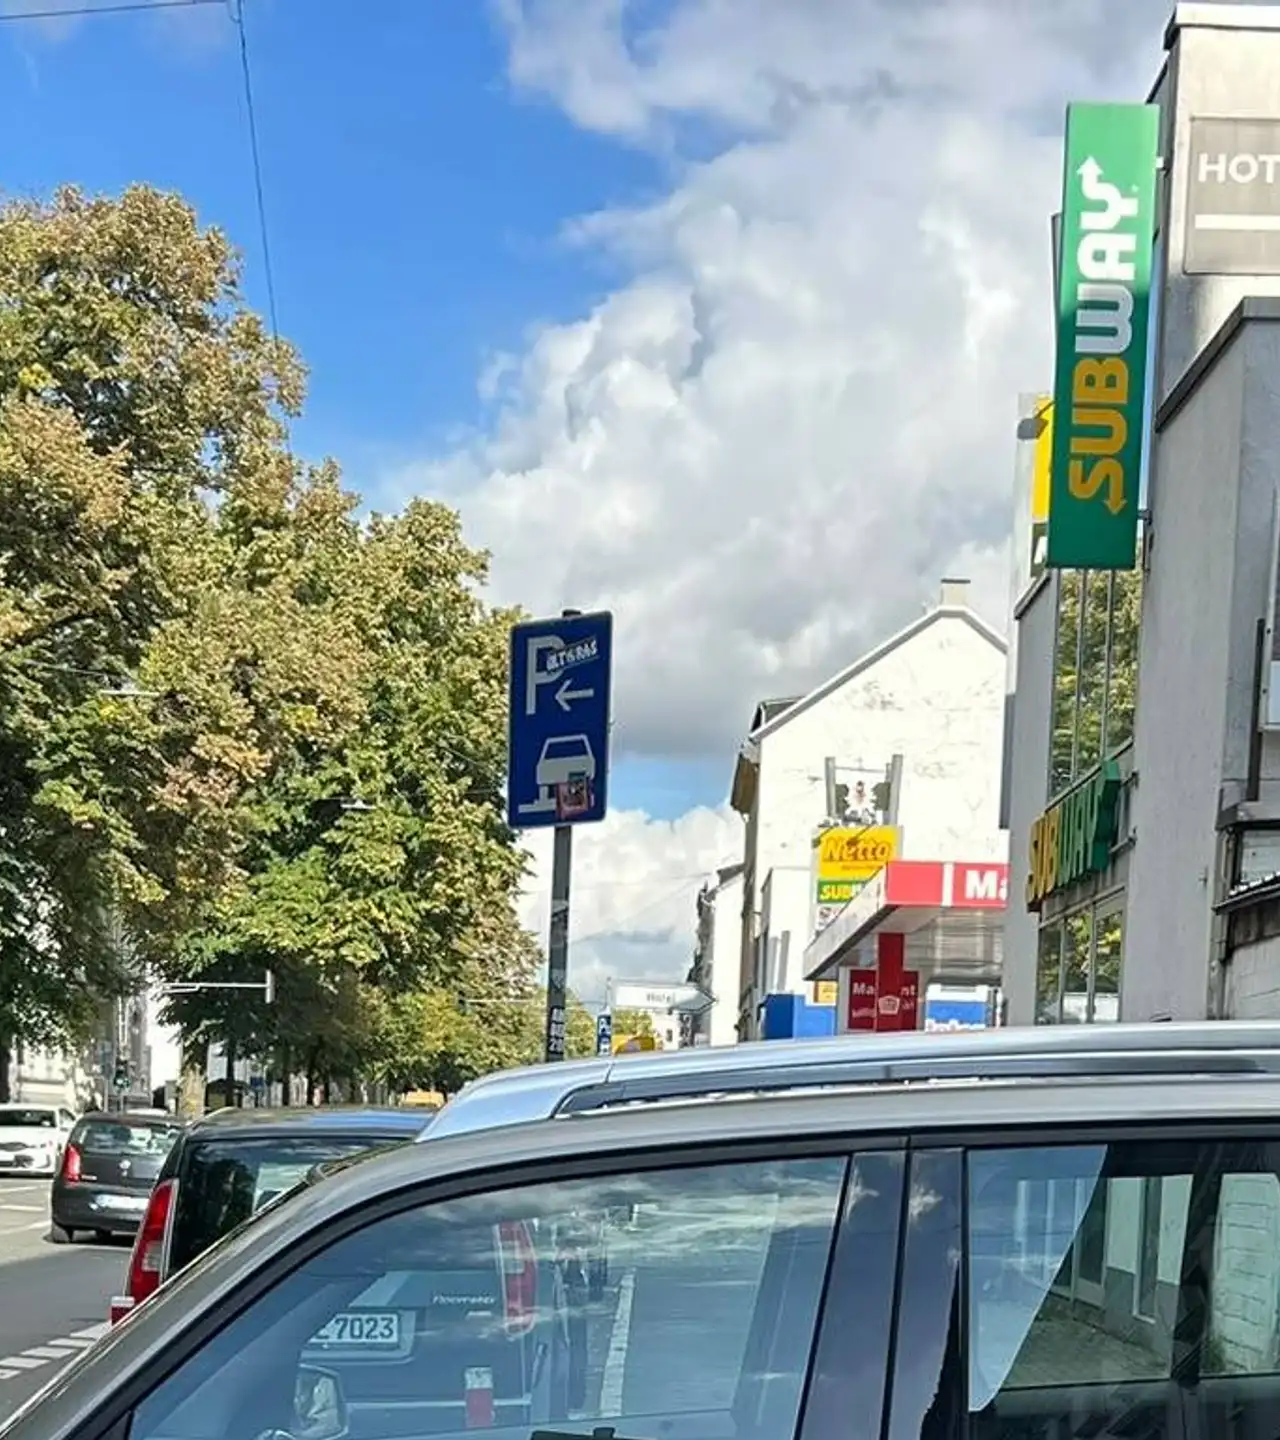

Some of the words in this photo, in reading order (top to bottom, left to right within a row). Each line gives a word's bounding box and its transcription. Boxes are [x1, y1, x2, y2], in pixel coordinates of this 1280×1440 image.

[1068, 155, 1139, 514] SUBWAY
[526, 635, 567, 715] P
[822, 835, 891, 862] Netto
[1024, 755, 1121, 903] SUBWAY
